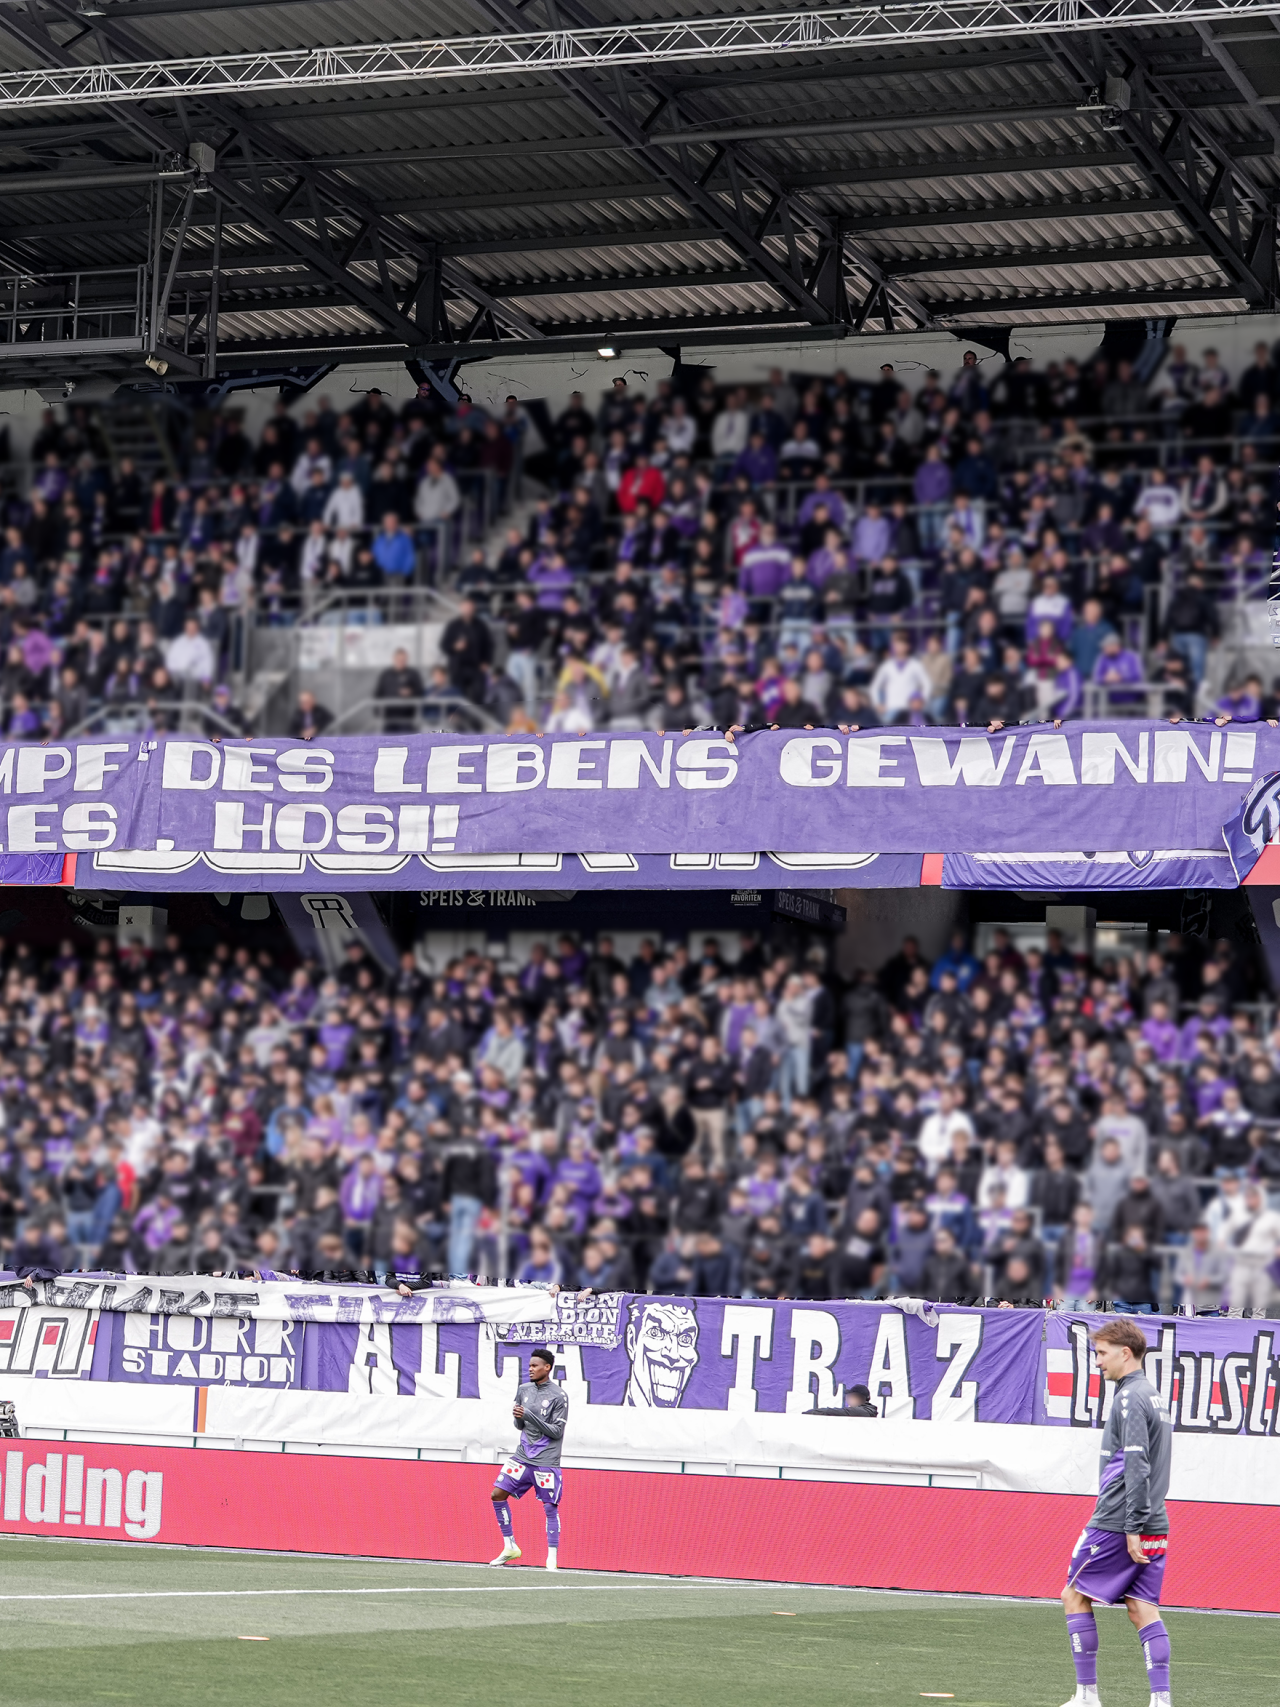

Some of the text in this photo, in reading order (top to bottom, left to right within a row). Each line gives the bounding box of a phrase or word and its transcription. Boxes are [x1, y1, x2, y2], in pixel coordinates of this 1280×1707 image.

[162, 741, 335, 792] DES
[373, 740, 739, 793] LEBENS
[780, 731, 1256, 787] GEWANN!
[420, 890, 464, 906] SPEIS
[730, 894, 762, 902] FAVORITEN
[778, 891, 795, 912] SPEIS
[122, 1348, 296, 1383] STADION
[720, 1304, 985, 1421] TRAZ
